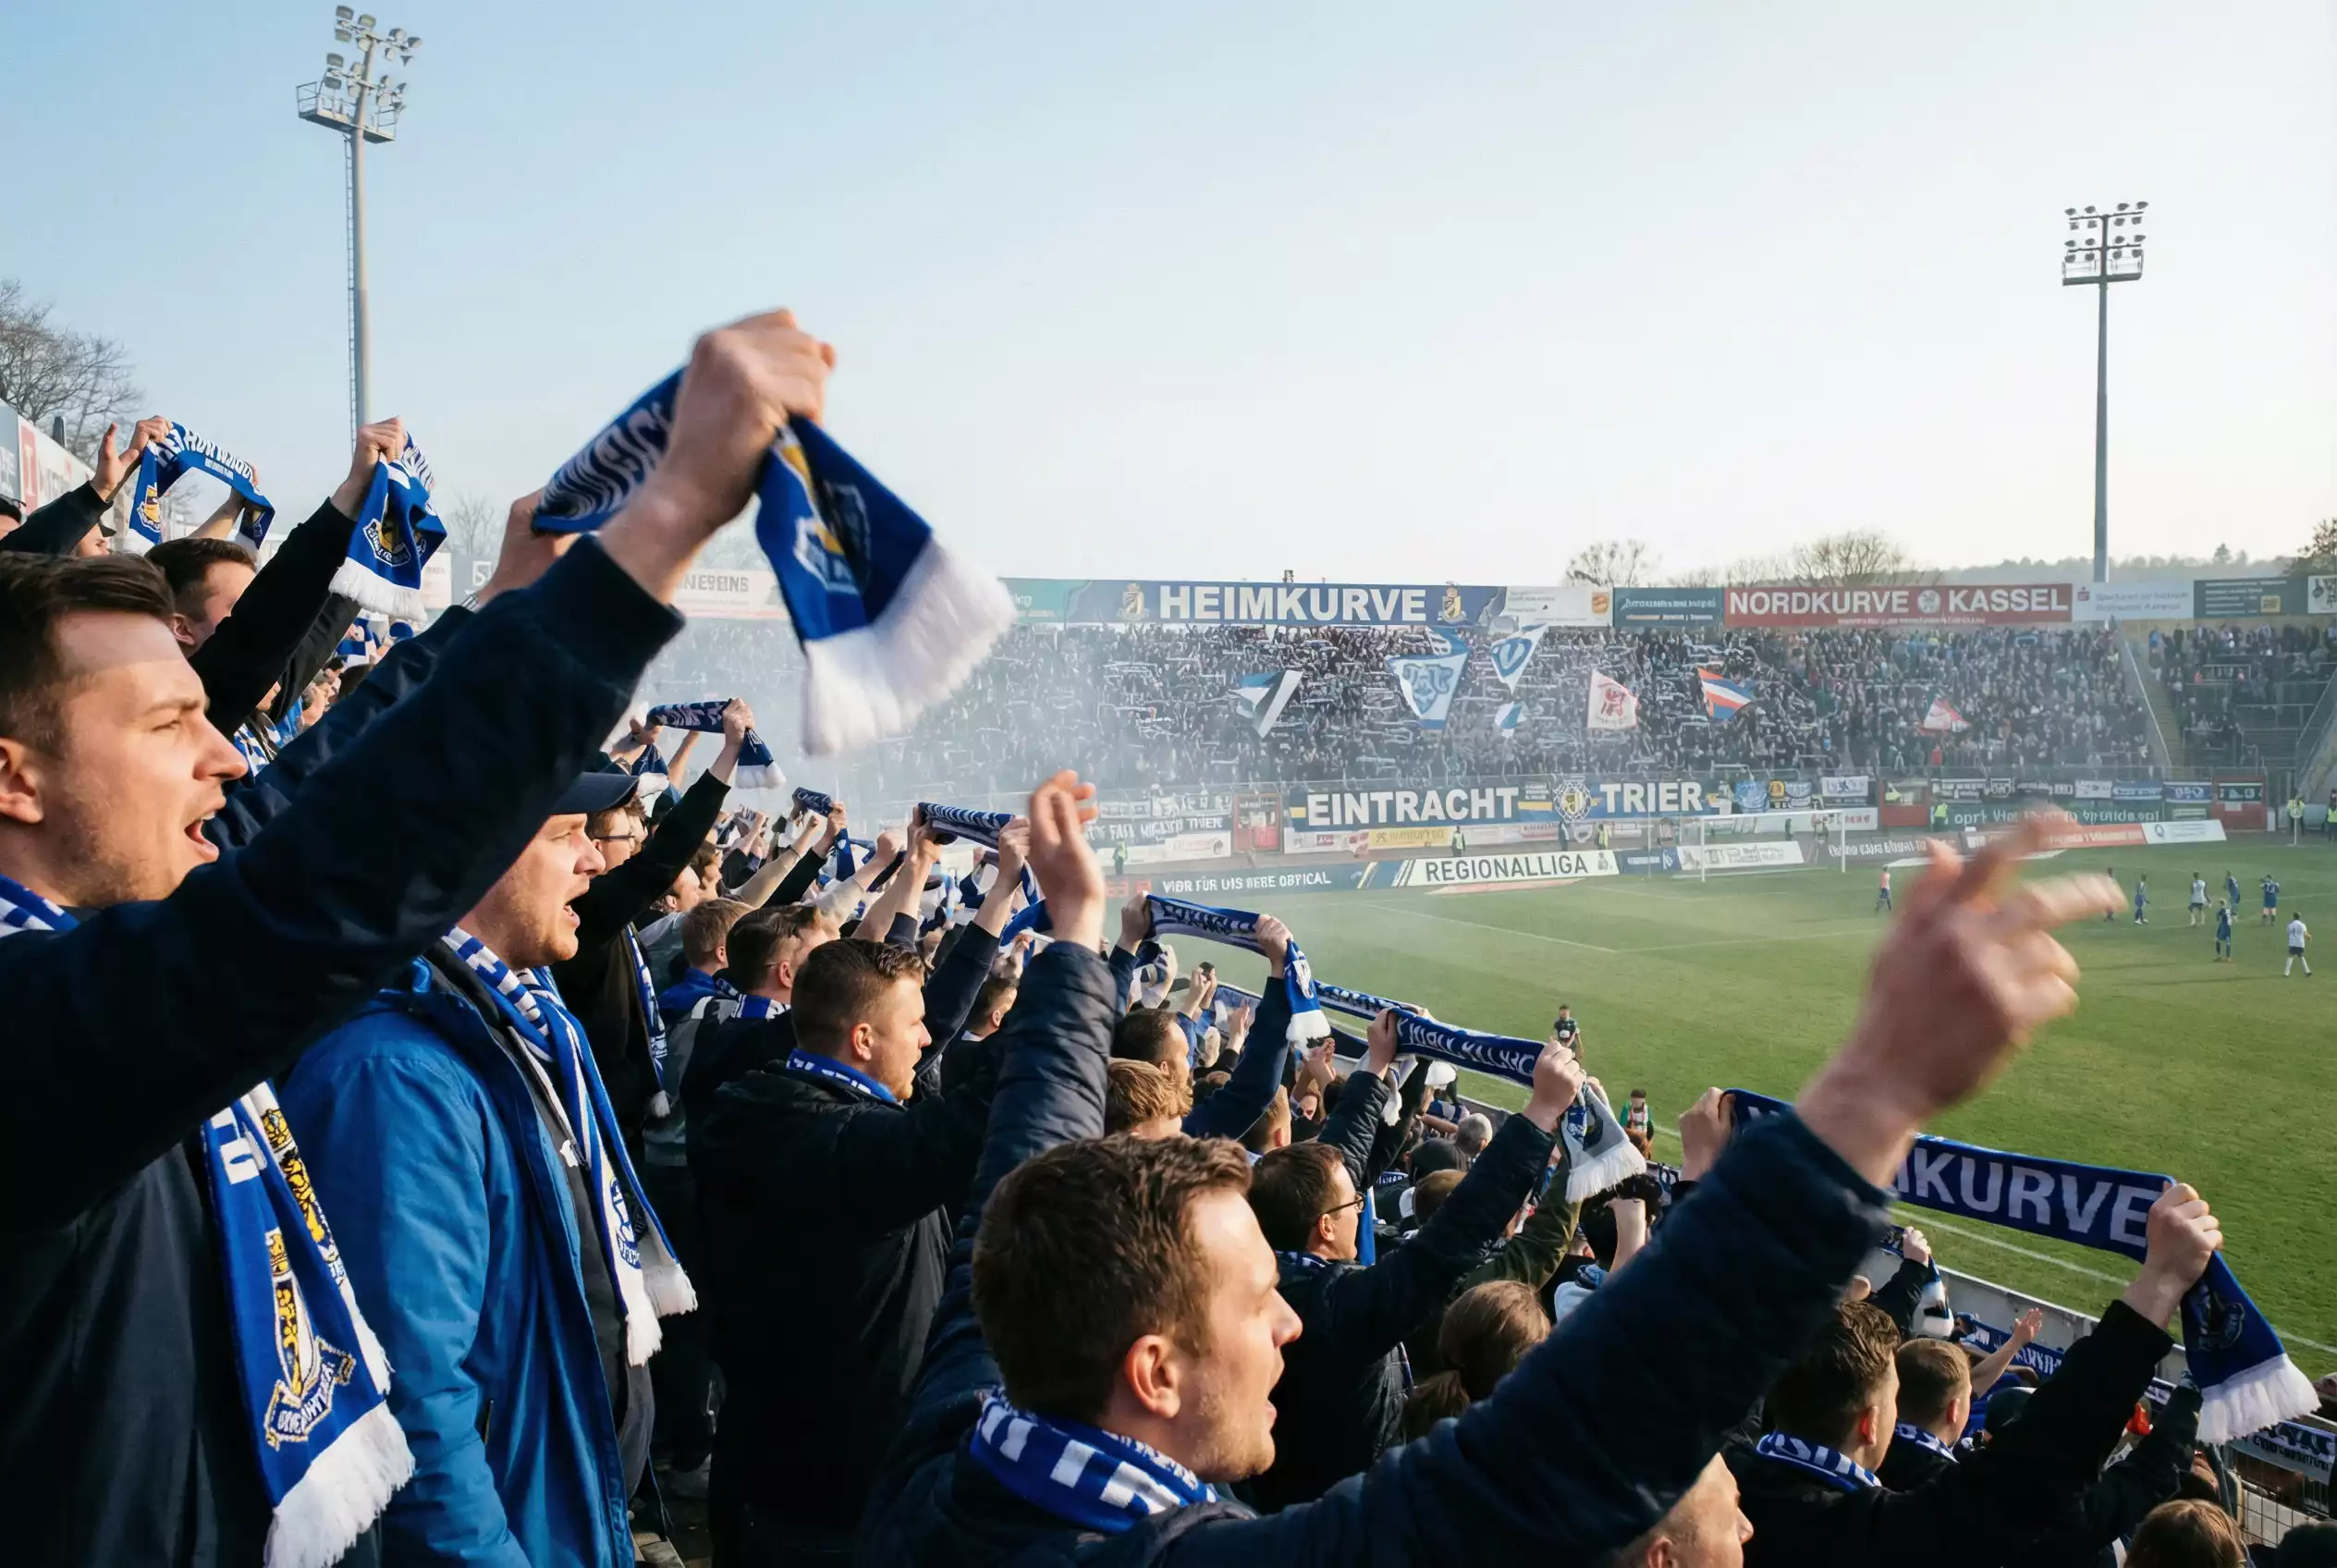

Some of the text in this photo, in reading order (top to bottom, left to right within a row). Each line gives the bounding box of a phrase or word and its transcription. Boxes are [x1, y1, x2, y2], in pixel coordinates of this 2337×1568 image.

[1159, 585, 1426, 621] HEIMKURVE
[1730, 589, 1909, 615] NORDKURVE
[1948, 588, 2068, 613] KASSEL
[1306, 786, 1519, 827] EINTRACHT
[1599, 781, 1704, 814] TRIER
[1425, 854, 1588, 882] REGIONALLIGA
